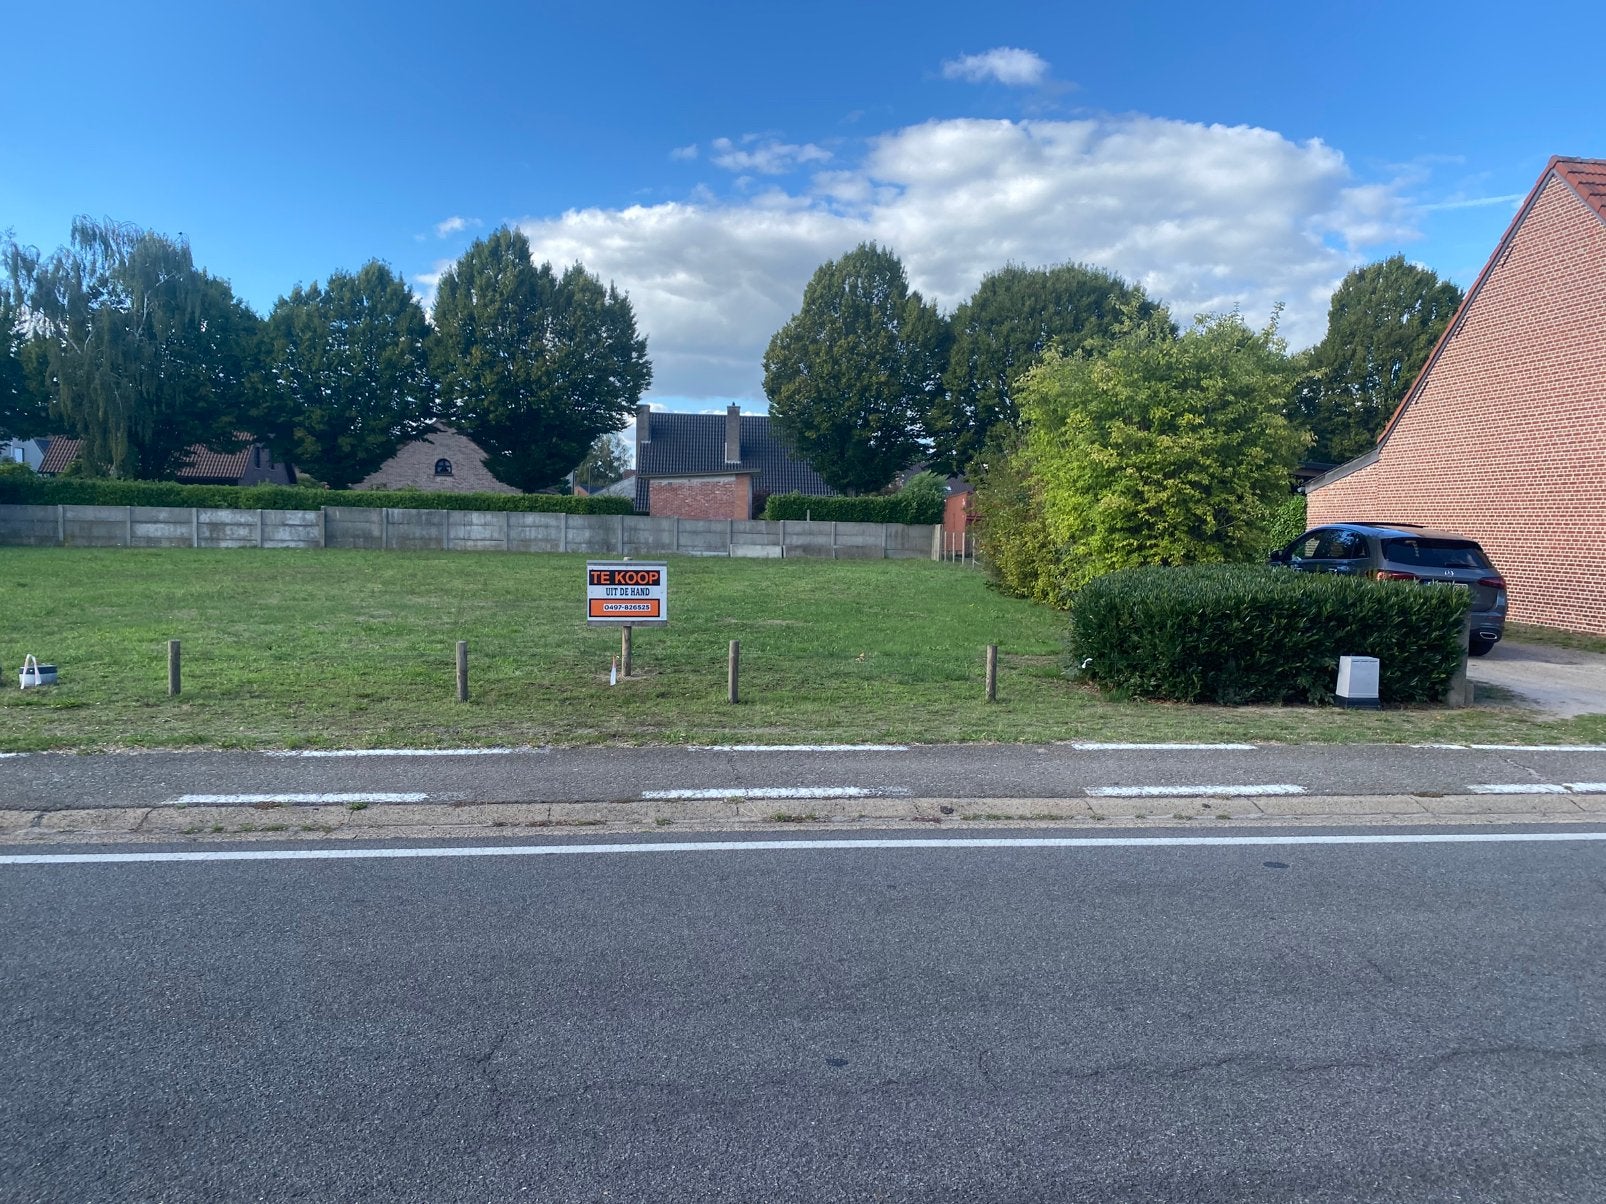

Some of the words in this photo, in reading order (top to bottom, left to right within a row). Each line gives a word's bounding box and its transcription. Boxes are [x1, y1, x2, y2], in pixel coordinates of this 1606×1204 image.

[591, 572, 610, 584] TE
[615, 572, 659, 584] KOOP
[606, 588, 618, 596] UIT
[620, 588, 630, 596] DE
[630, 588, 650, 596] HAND
